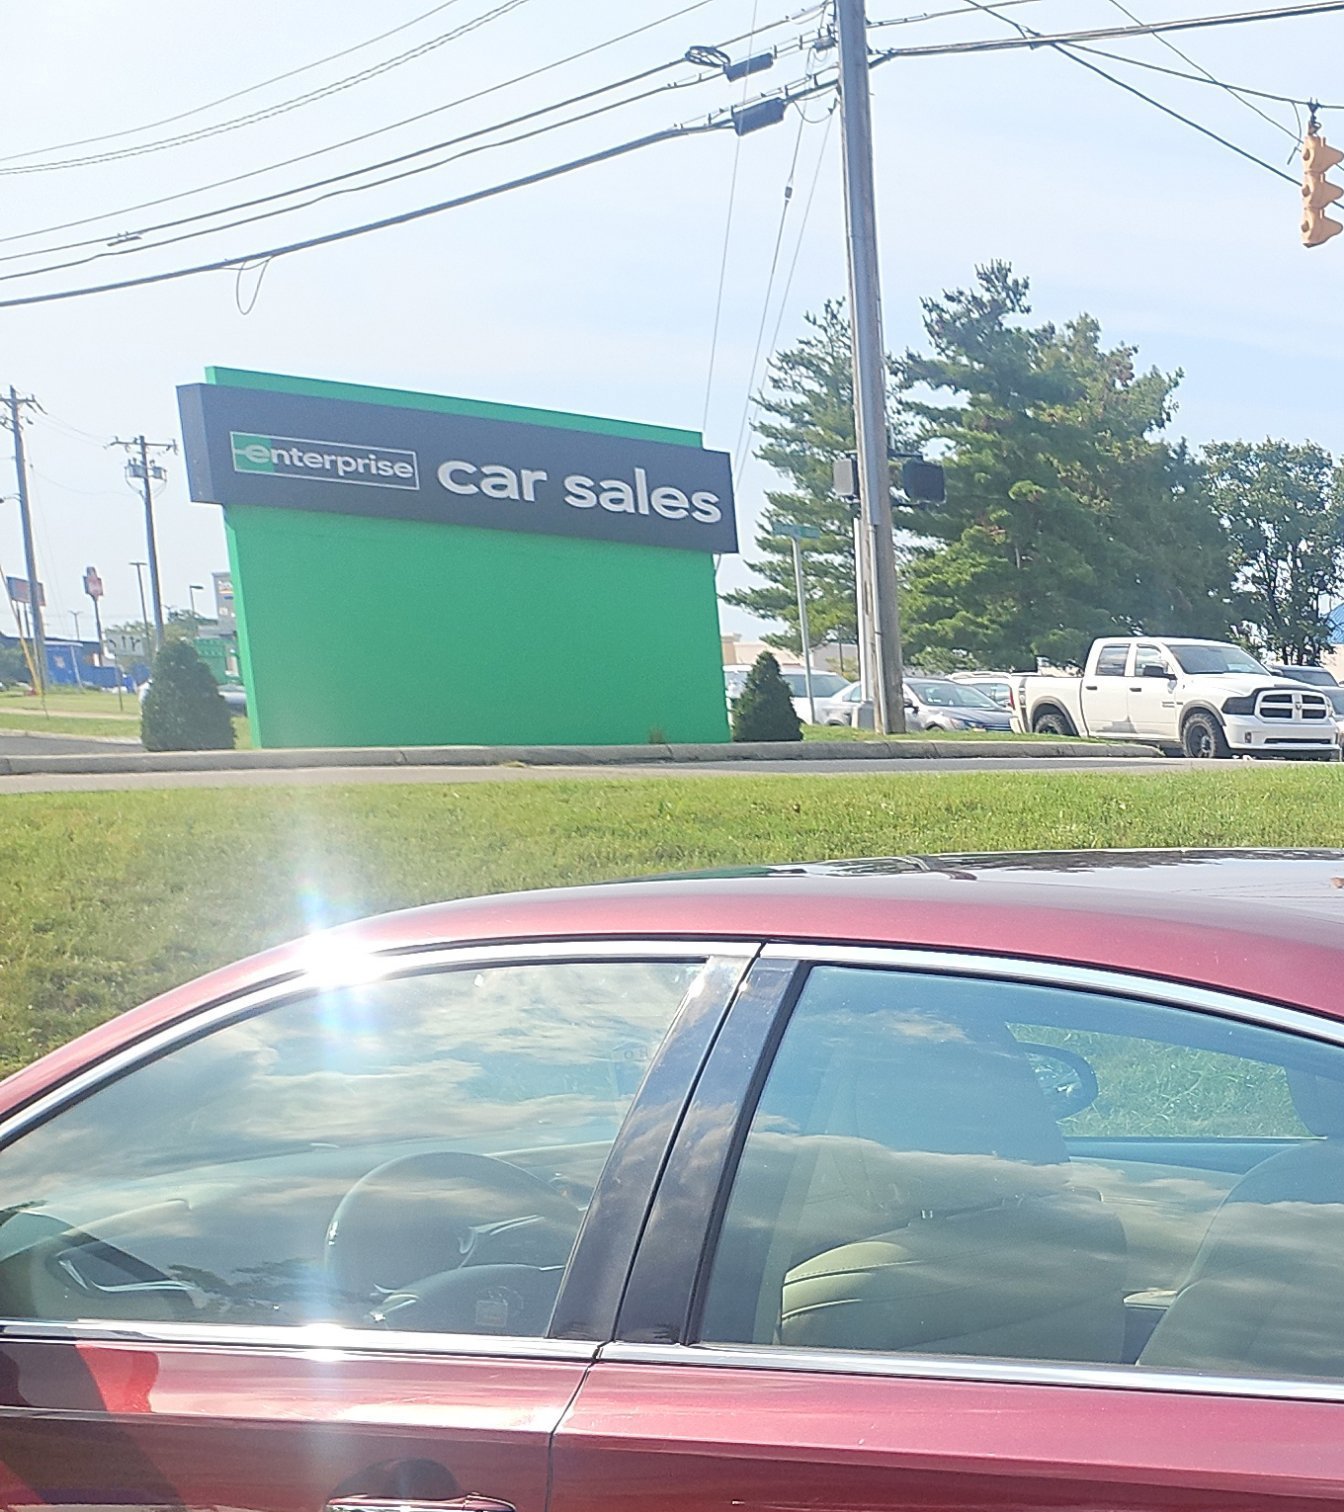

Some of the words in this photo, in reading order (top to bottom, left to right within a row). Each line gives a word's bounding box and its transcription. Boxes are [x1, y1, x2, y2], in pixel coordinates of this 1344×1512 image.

[236, 443, 415, 478] enterprise
[437, 460, 548, 502] car
[564, 467, 723, 524] sales
